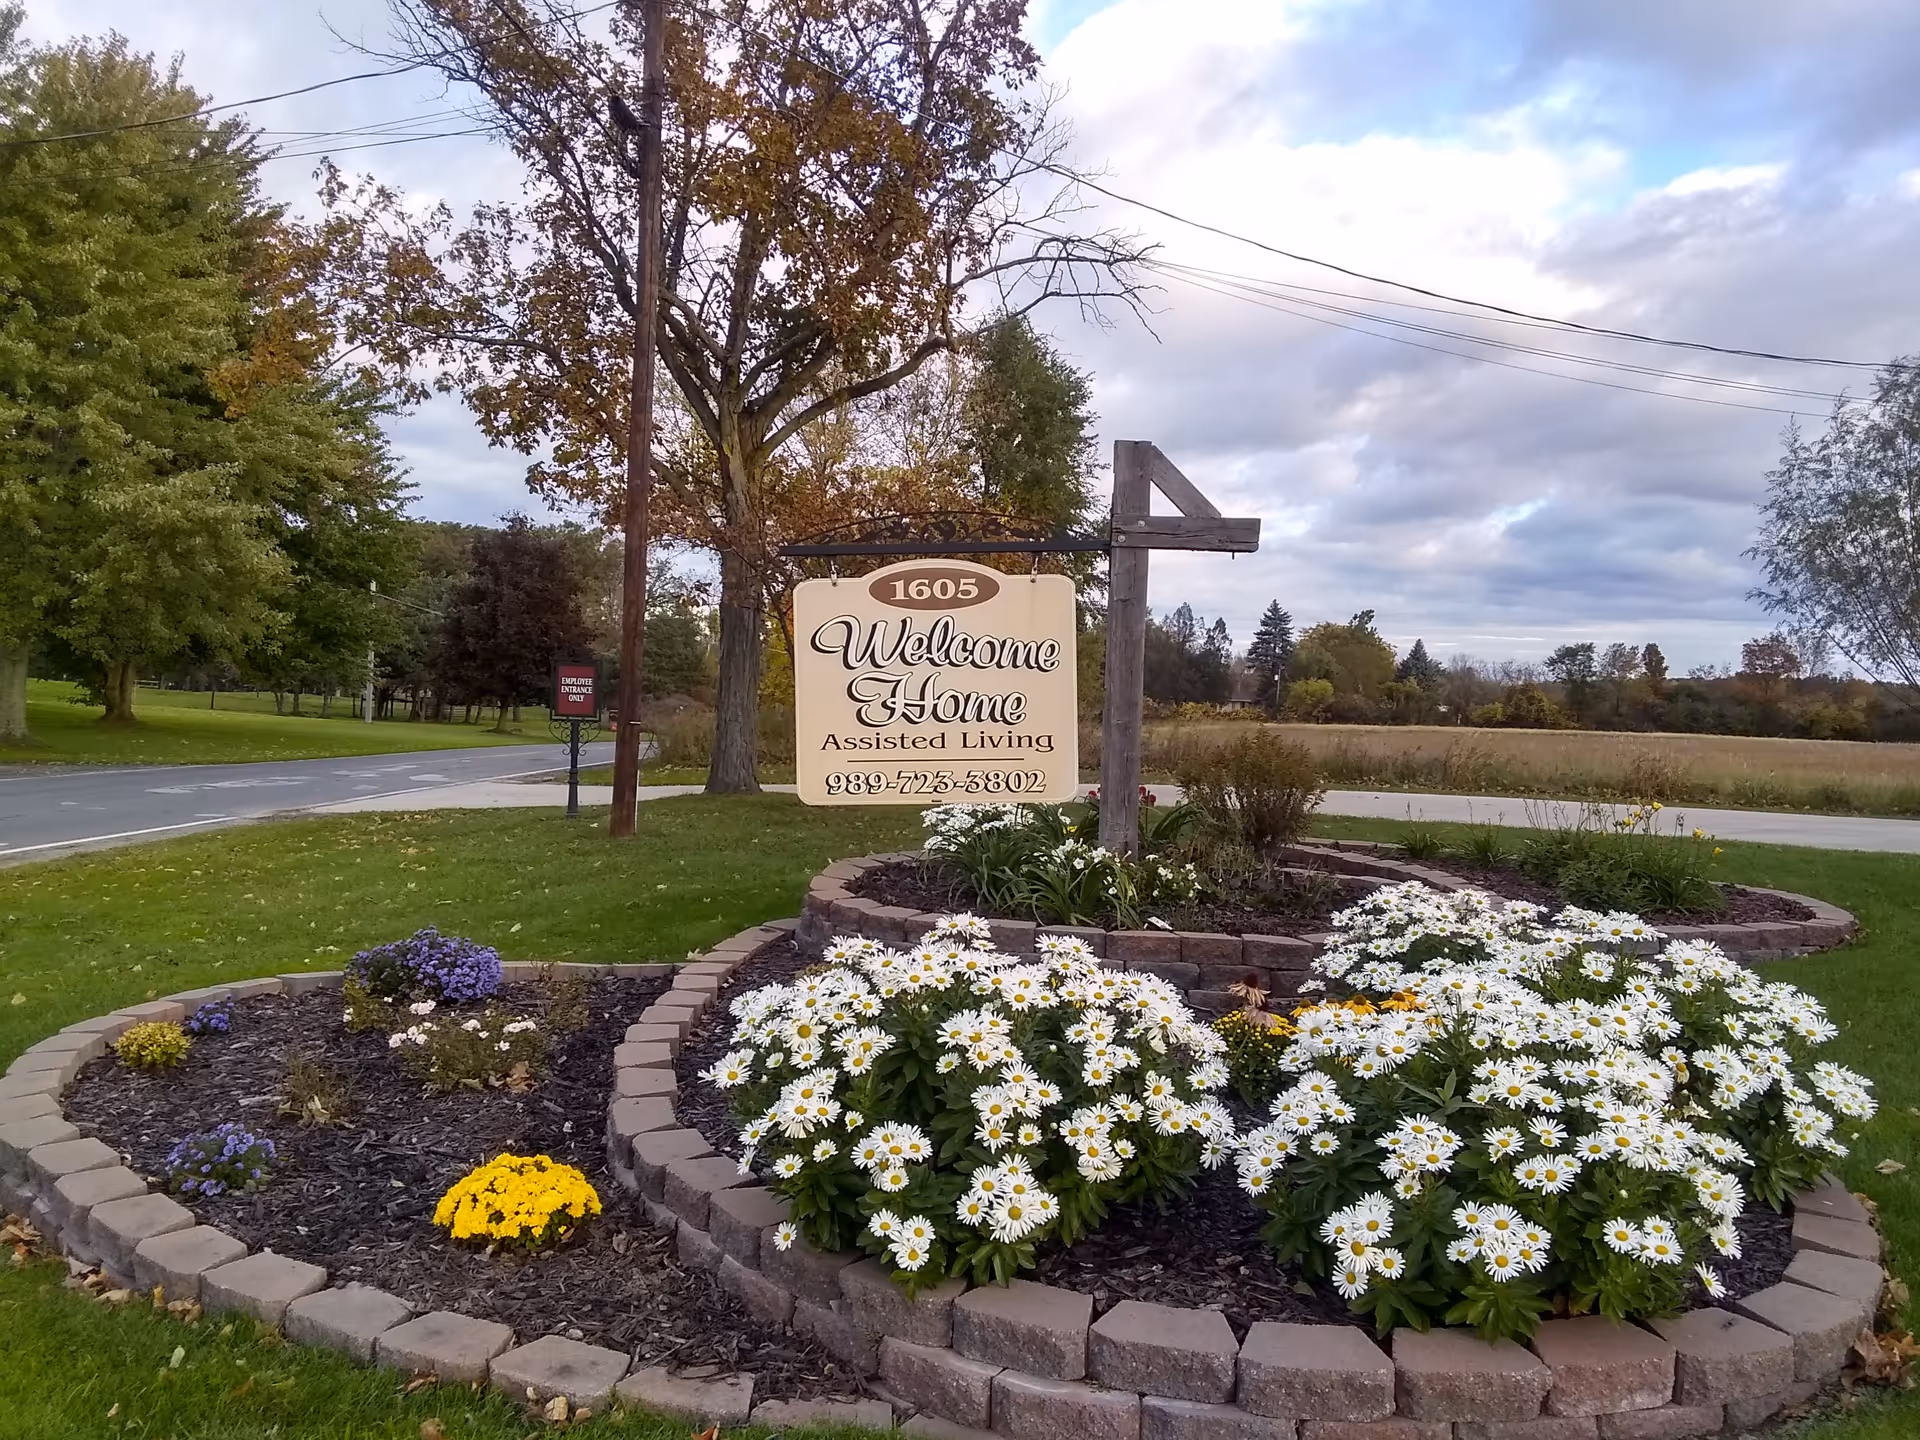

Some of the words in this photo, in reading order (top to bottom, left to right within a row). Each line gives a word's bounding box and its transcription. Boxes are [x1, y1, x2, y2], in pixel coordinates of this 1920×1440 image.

[890, 578, 979, 600] 1605
[810, 614, 1060, 672] Welcome
[561, 677, 593, 685] EMPLOYEE
[561, 686, 593, 694] ENTRANCE
[568, 694, 584, 702] ONLY
[847, 671, 1027, 727] Home
[820, 731, 946, 751] Assisted
[960, 730, 1055, 753] Living
[825, 769, 1046, 796] 989-723-3802
